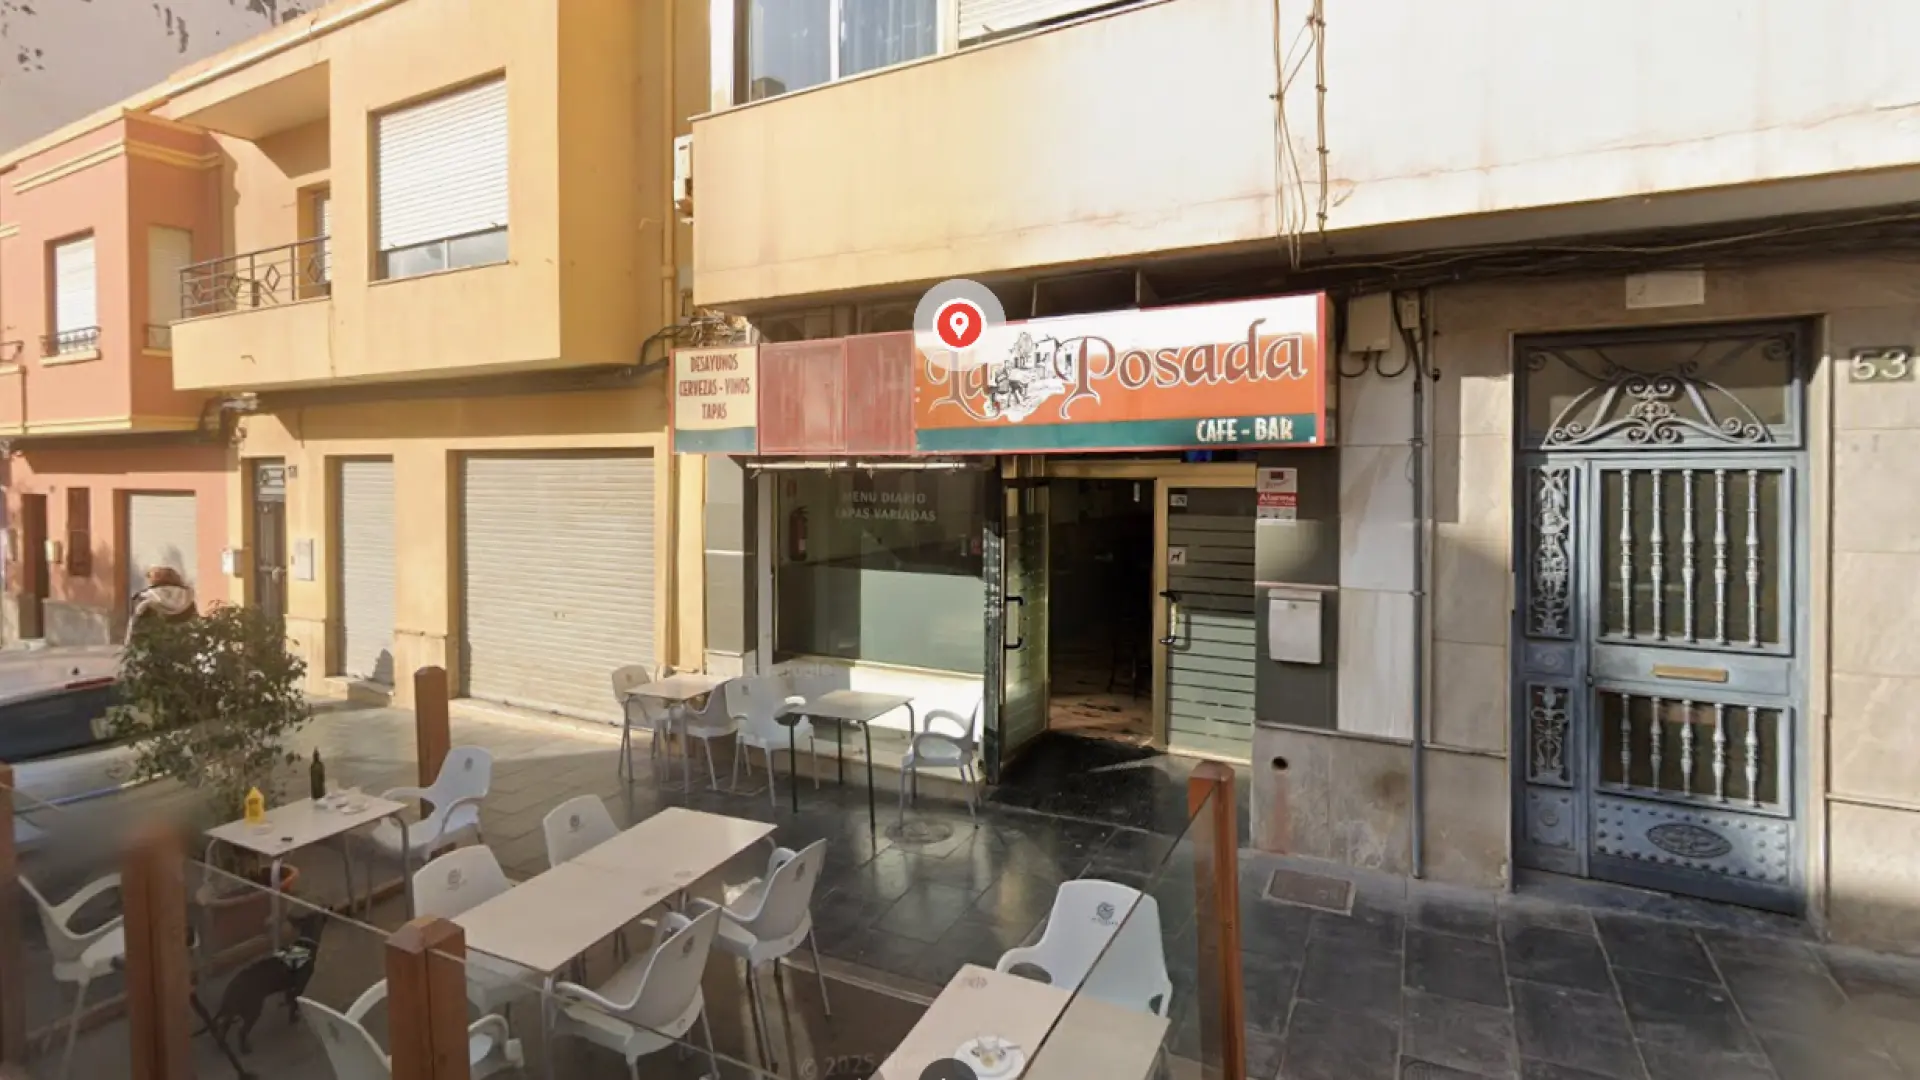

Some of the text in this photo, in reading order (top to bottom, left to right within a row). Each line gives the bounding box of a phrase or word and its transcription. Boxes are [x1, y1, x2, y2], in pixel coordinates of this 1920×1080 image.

[690, 354, 739, 372] DESAYUNOS
[925, 318, 1309, 421] La Posada
[1852, 350, 1907, 381] 53
[679, 379, 717, 396] CERVEZAS
[725, 377, 750, 395] VINOS
[702, 402, 727, 419] TAPAS
[1196, 418, 1238, 442] CAFE
[1255, 416, 1293, 441] BAR
[881, 491, 927, 504] DIARIO
[873, 508, 936, 522] VARIADAS
